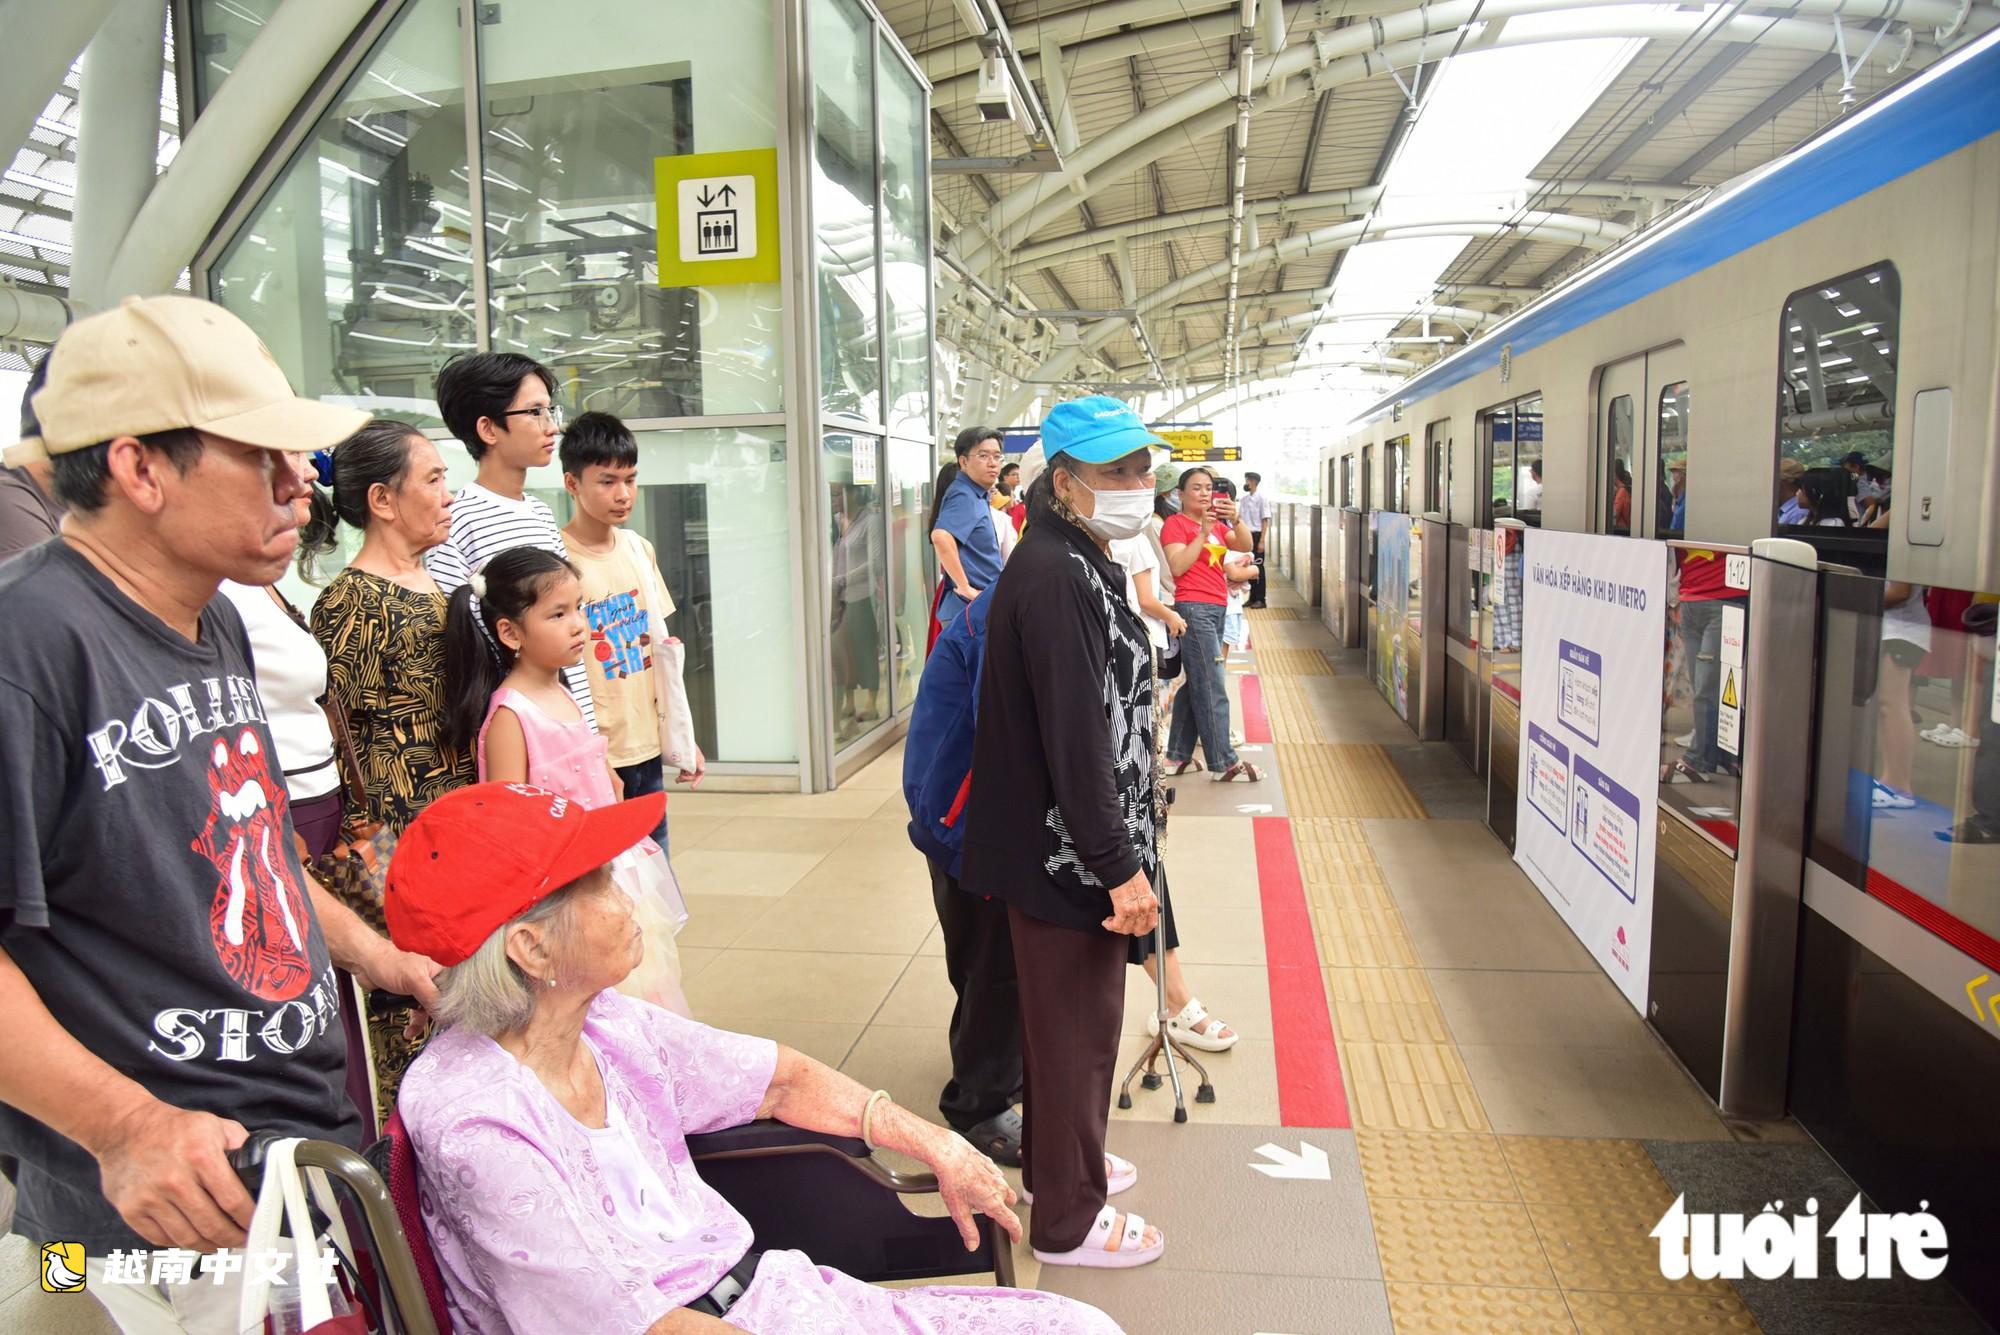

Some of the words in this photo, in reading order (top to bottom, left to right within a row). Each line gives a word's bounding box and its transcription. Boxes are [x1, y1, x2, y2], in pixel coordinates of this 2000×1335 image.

[1532, 562, 1545, 585] VĂN
[1545, 565, 1558, 589] HÓA
[1559, 565, 1571, 592] XẾP
[1572, 570, 1592, 597] HÀNG
[1593, 579, 1606, 601] KHI
[1608, 582, 1617, 604] ĐI
[1618, 584, 1647, 611] METRO
[1729, 559, 1745, 585] 1-12
